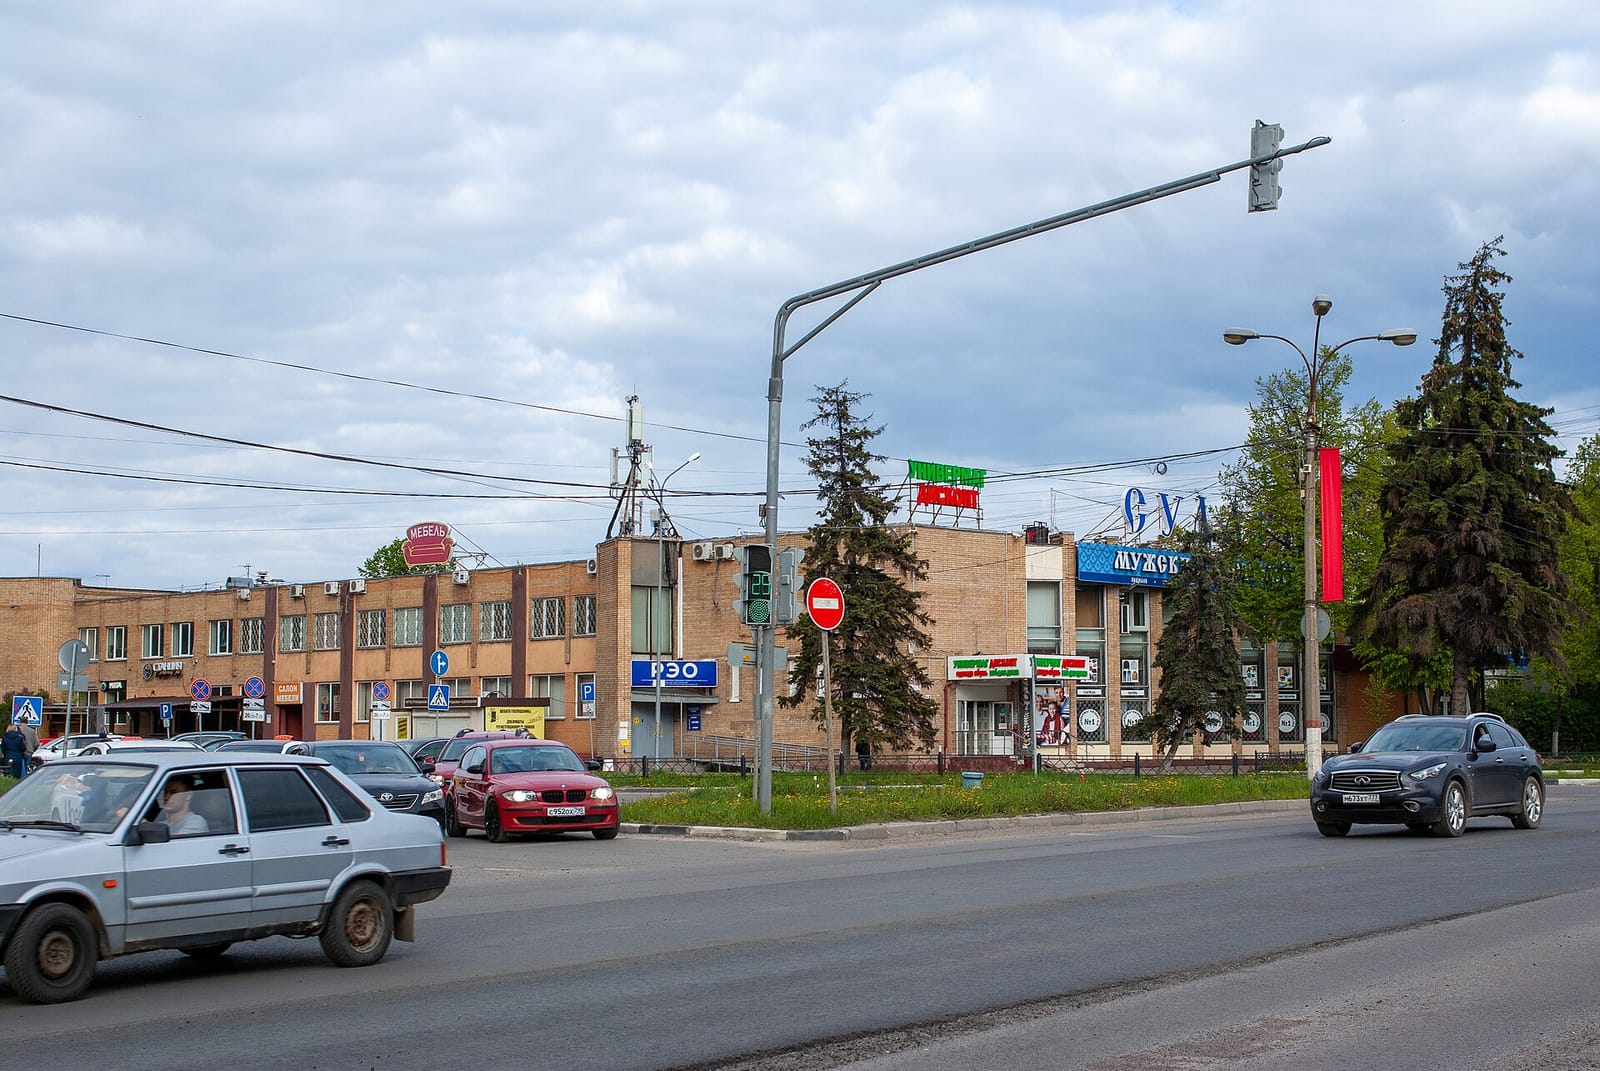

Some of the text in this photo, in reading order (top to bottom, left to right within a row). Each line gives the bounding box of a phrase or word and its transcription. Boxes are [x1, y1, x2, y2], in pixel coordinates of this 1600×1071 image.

[908, 458, 987, 488] УНИВЕРМАГ
[917, 482, 979, 509] ДИСКОНТ
[410, 525, 446, 540] МЕБЕЛЬ
[1114, 550, 1191, 576] МУЖСК
[752, 573, 771, 595] 25
[651, 662, 698, 678] РЭО
[278, 684, 298, 693] САЛОН
